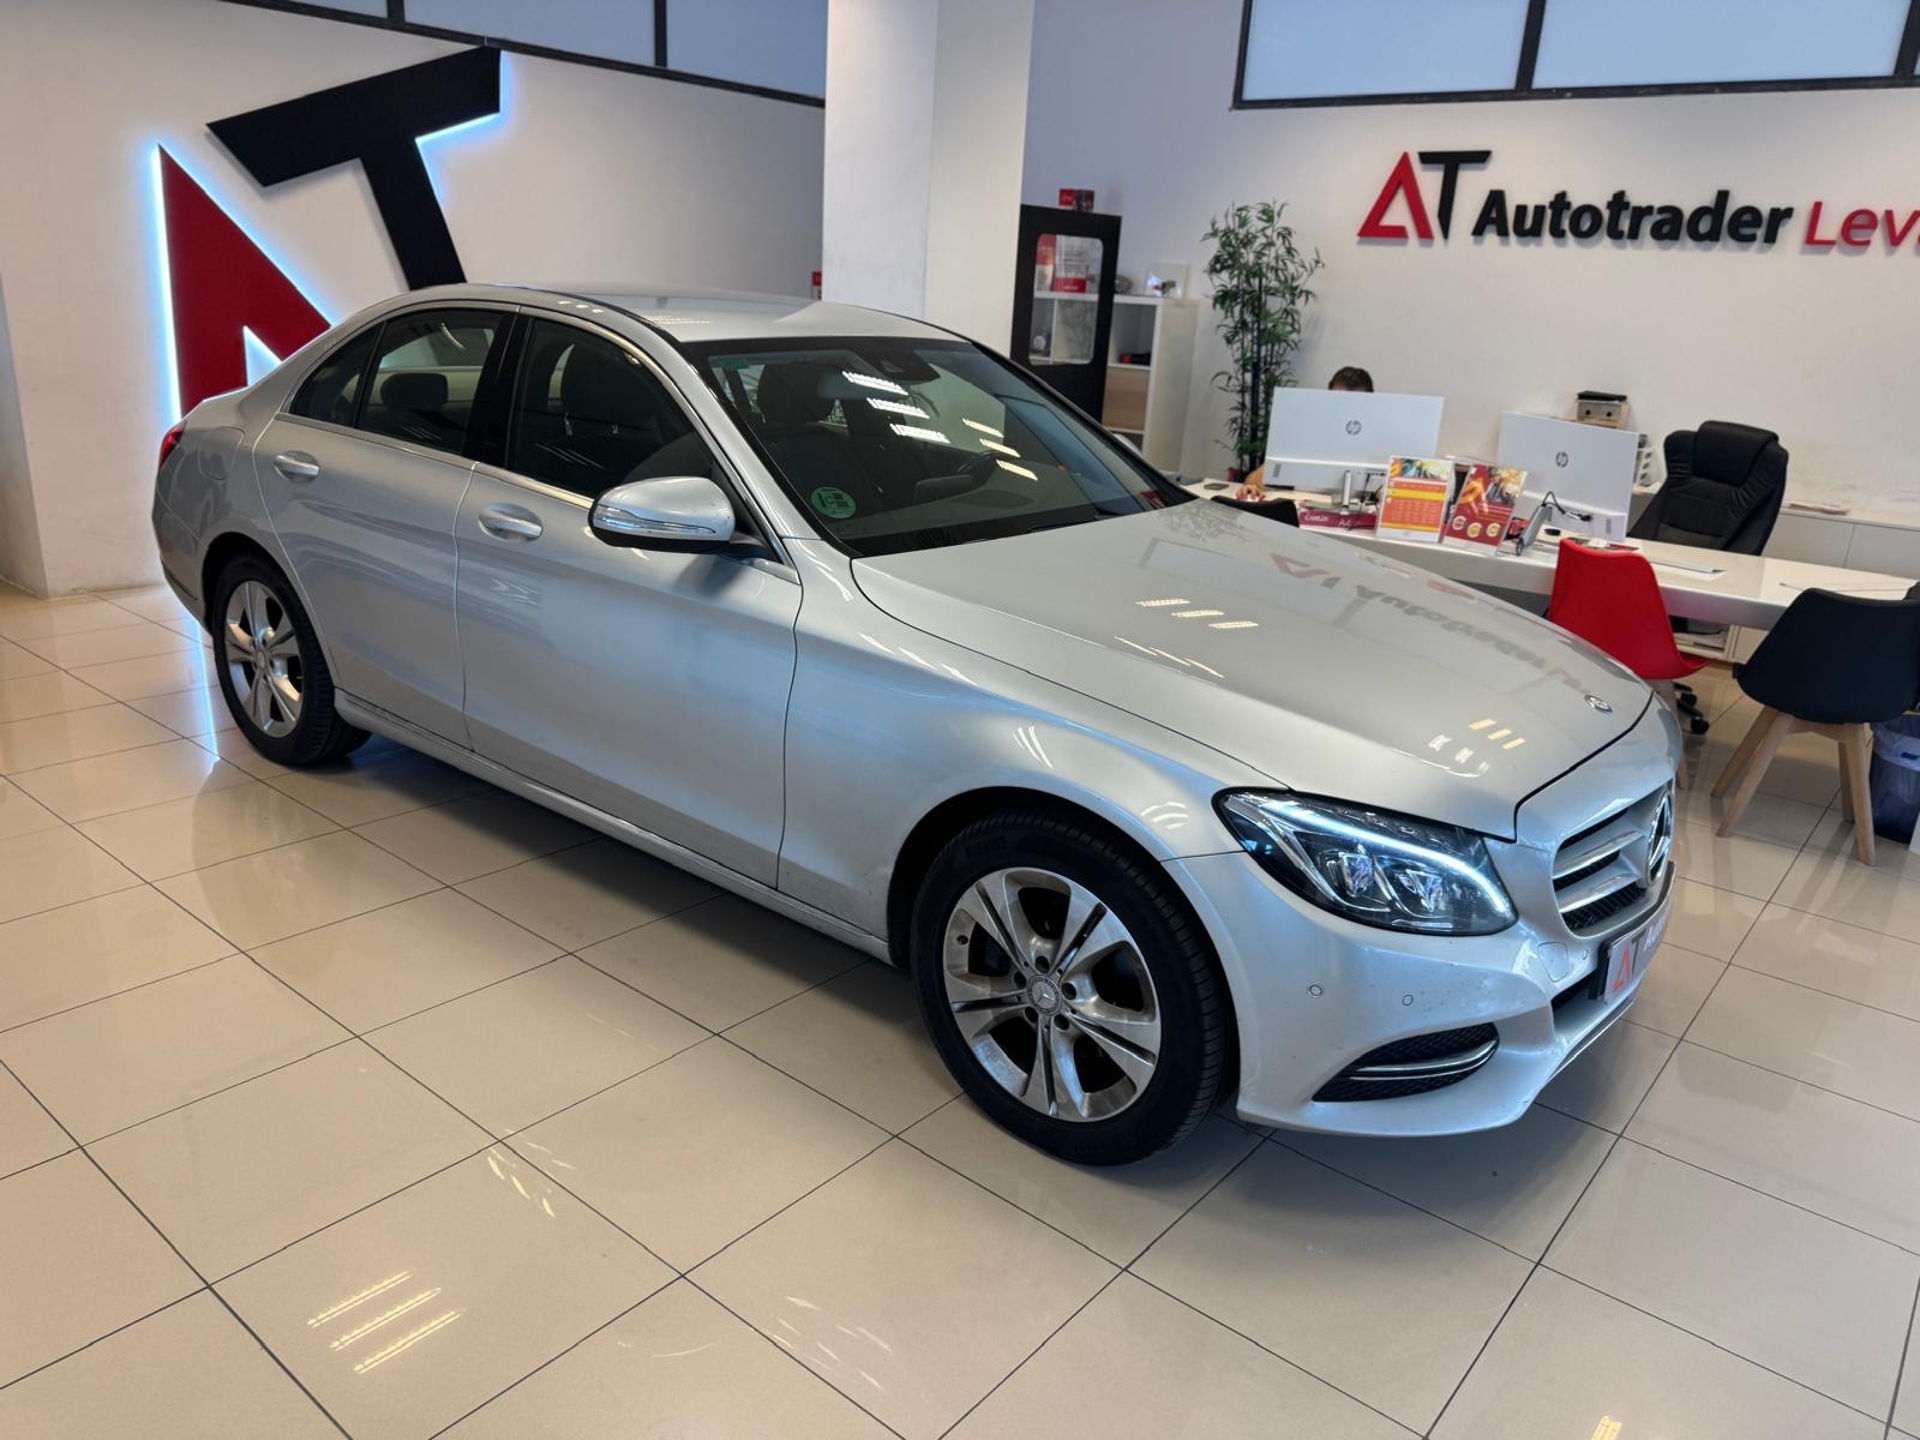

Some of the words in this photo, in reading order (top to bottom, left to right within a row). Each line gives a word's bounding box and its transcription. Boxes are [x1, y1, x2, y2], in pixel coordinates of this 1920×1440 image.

[1357, 150, 1493, 241] AT
[1471, 189, 1794, 244] Autotrader
[1805, 200, 1920, 247] Lev
